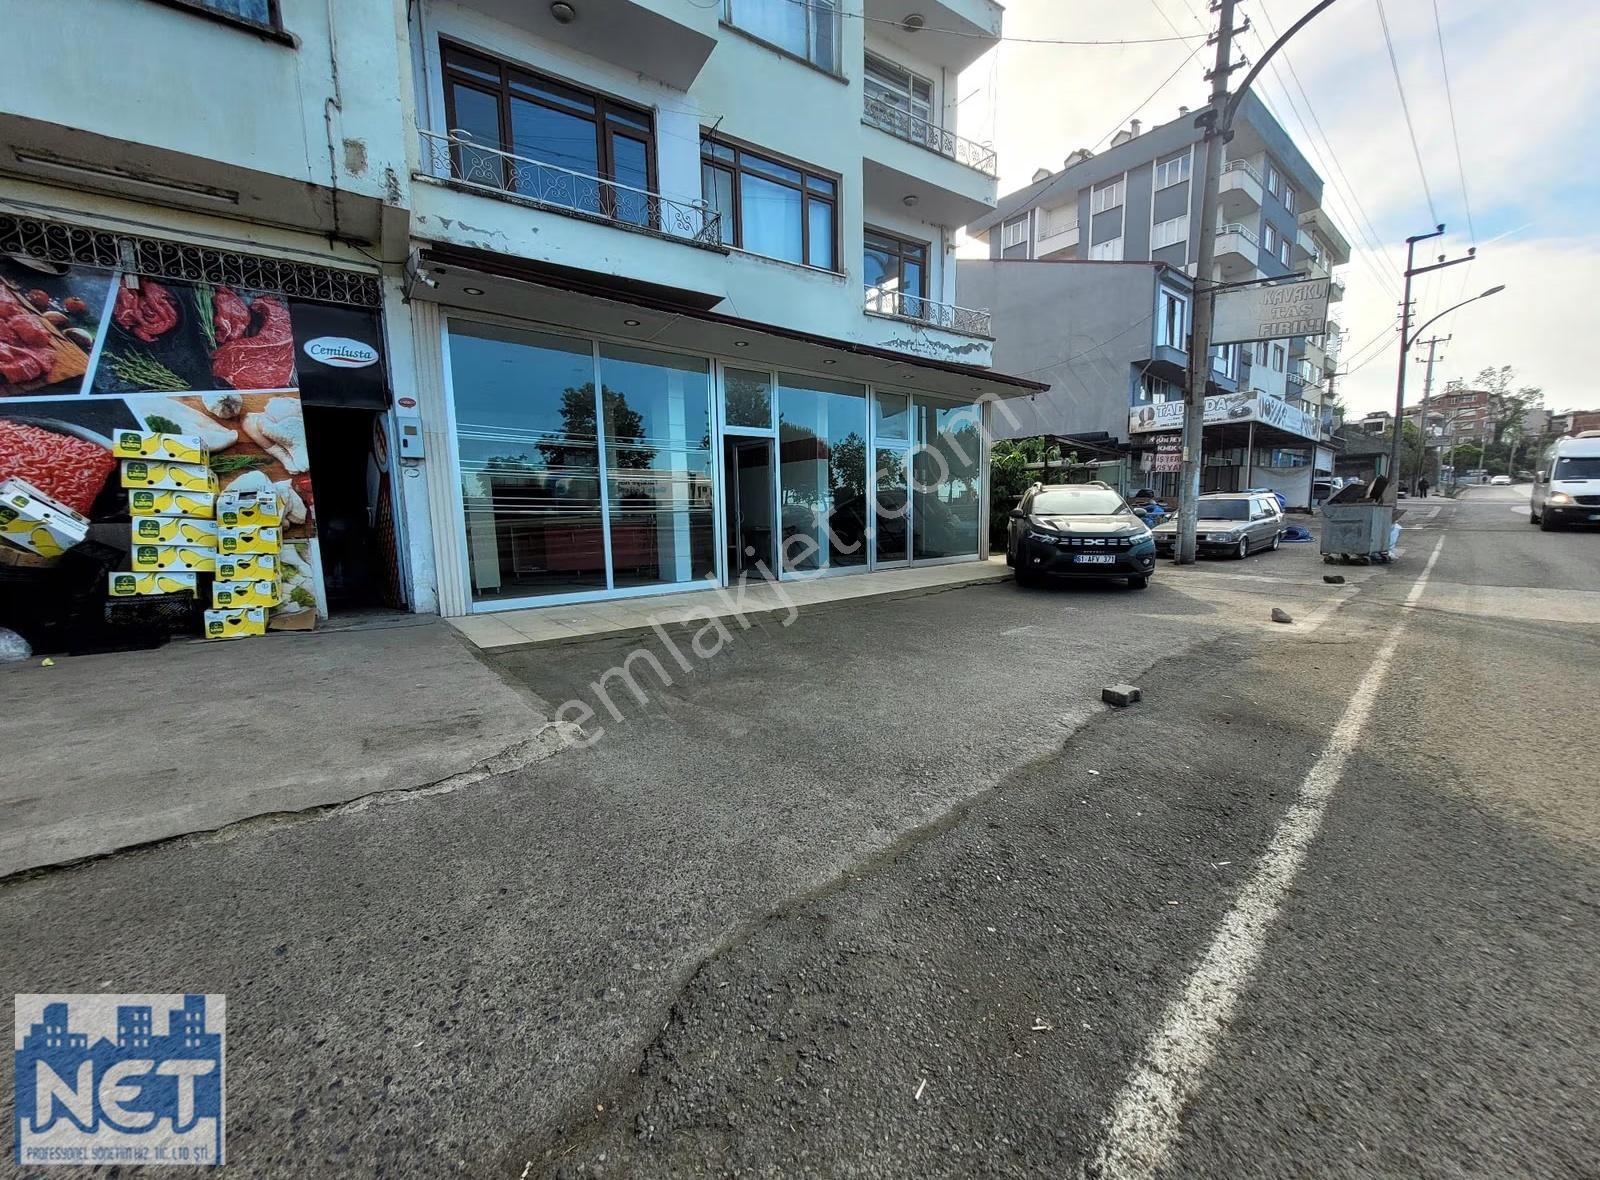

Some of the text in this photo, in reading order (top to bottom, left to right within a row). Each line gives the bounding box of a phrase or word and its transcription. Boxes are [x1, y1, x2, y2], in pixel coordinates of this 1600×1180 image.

[1263, 282, 1328, 306] KAVAKLI
[1259, 317, 1324, 337] FIRINI
[310, 344, 372, 359] Cemilusta
